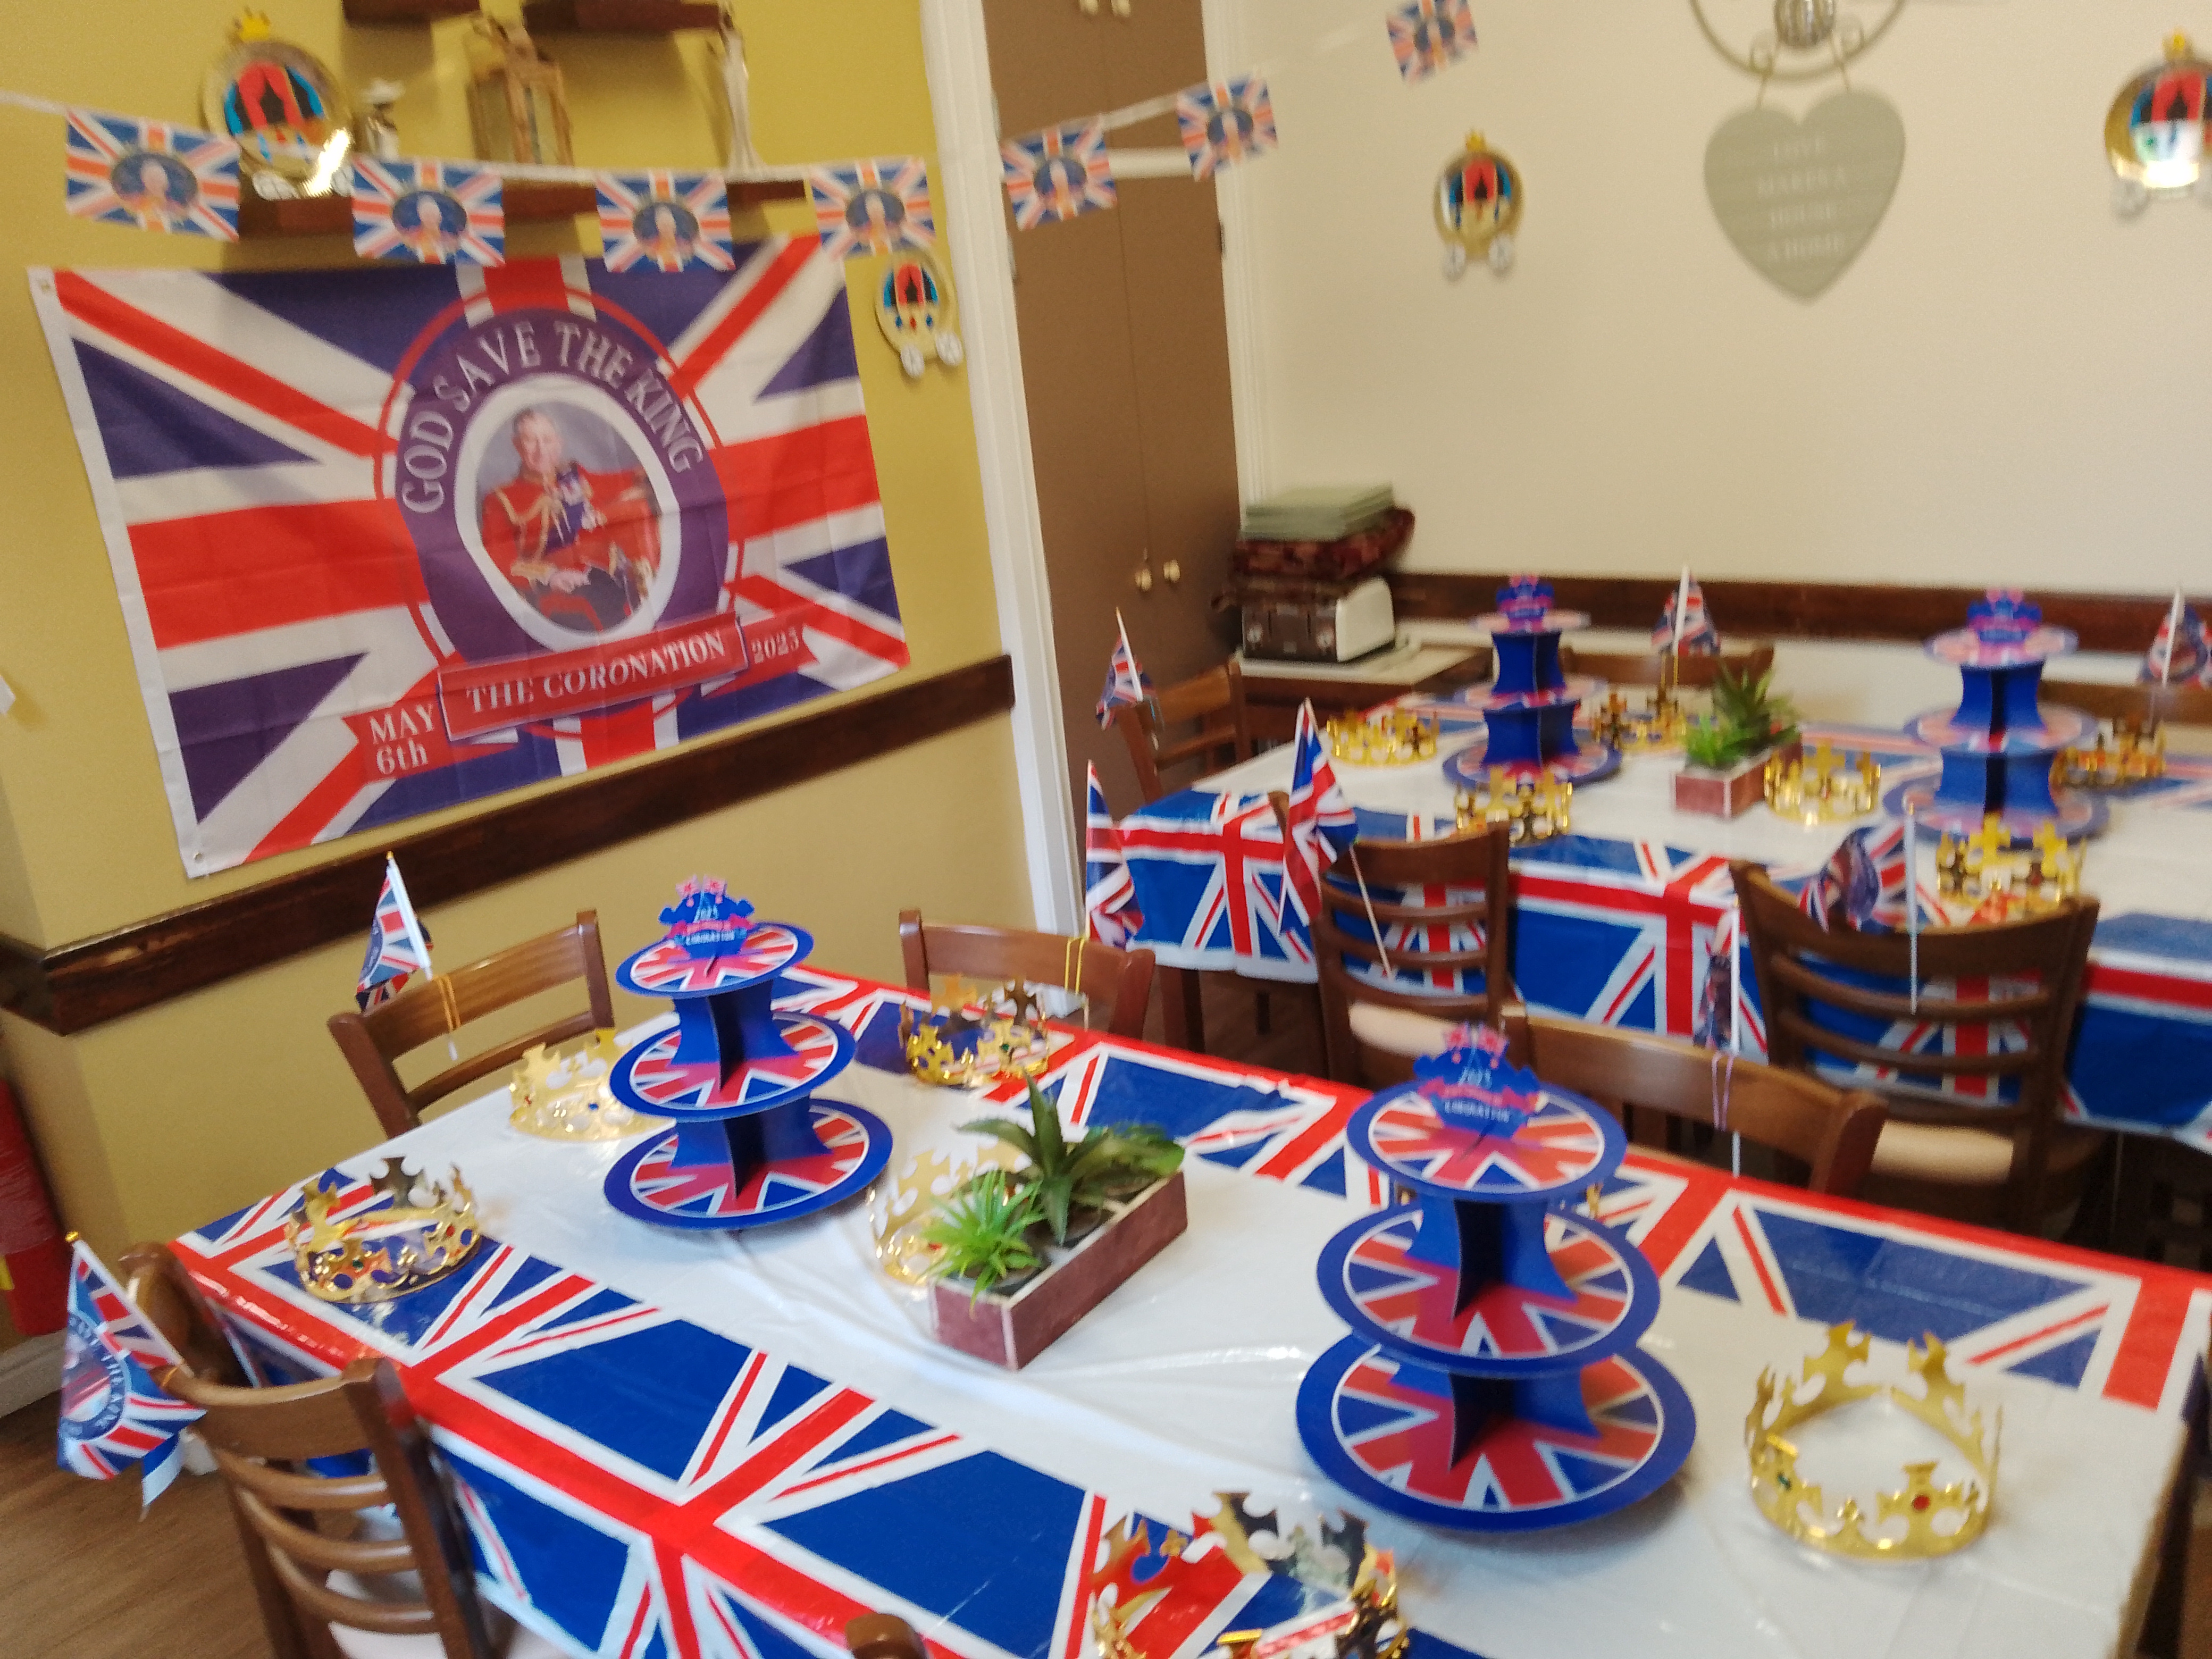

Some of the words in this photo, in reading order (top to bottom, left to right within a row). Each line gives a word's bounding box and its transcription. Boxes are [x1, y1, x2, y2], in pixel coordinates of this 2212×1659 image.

[401, 410, 454, 513] GOD
[432, 320, 541, 413] SAVE
[553, 320, 633, 389] THE
[624, 368, 702, 473] KING
[466, 678, 534, 713] THE
[543, 630, 725, 698] CORONATION
[751, 626, 799, 664] 2023
[370, 703, 433, 744] MAY
[376, 738, 428, 774] 6th
